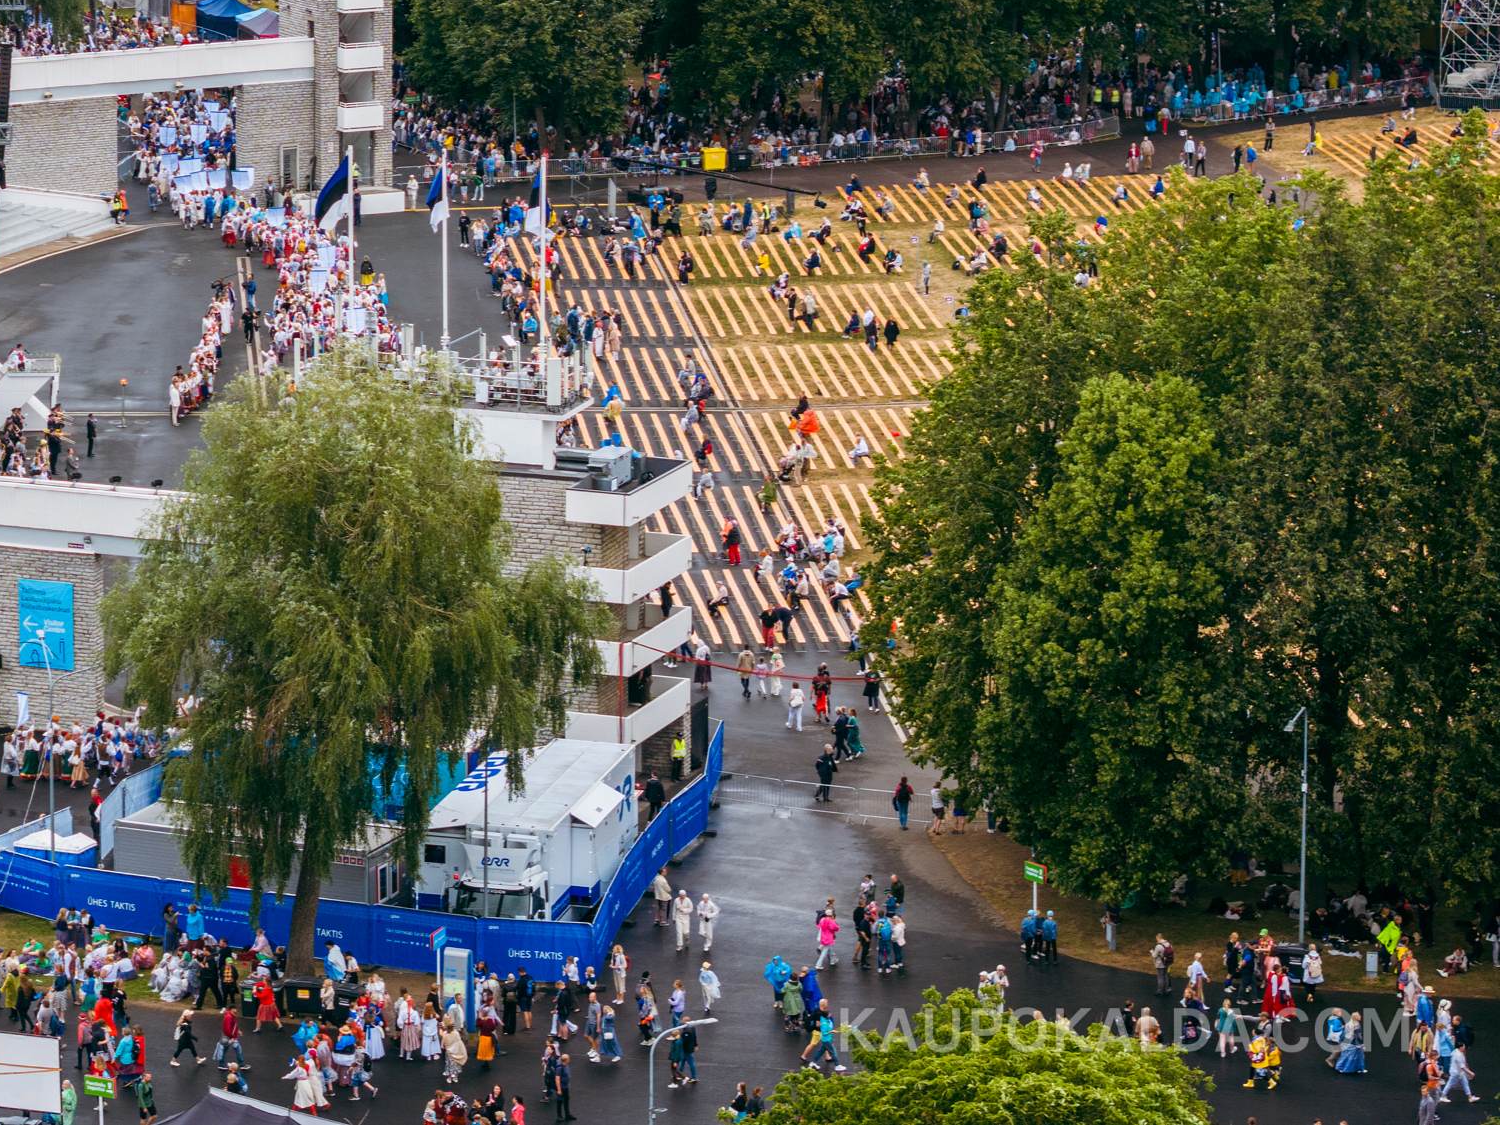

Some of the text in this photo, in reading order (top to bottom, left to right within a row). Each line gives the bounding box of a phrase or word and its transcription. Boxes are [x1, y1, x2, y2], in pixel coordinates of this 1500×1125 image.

[87, 895, 136, 912] ÜHES TAKTIS
[316, 927, 344, 939] TAKTIS
[507, 947, 564, 961] ÜHES TAKTIS
